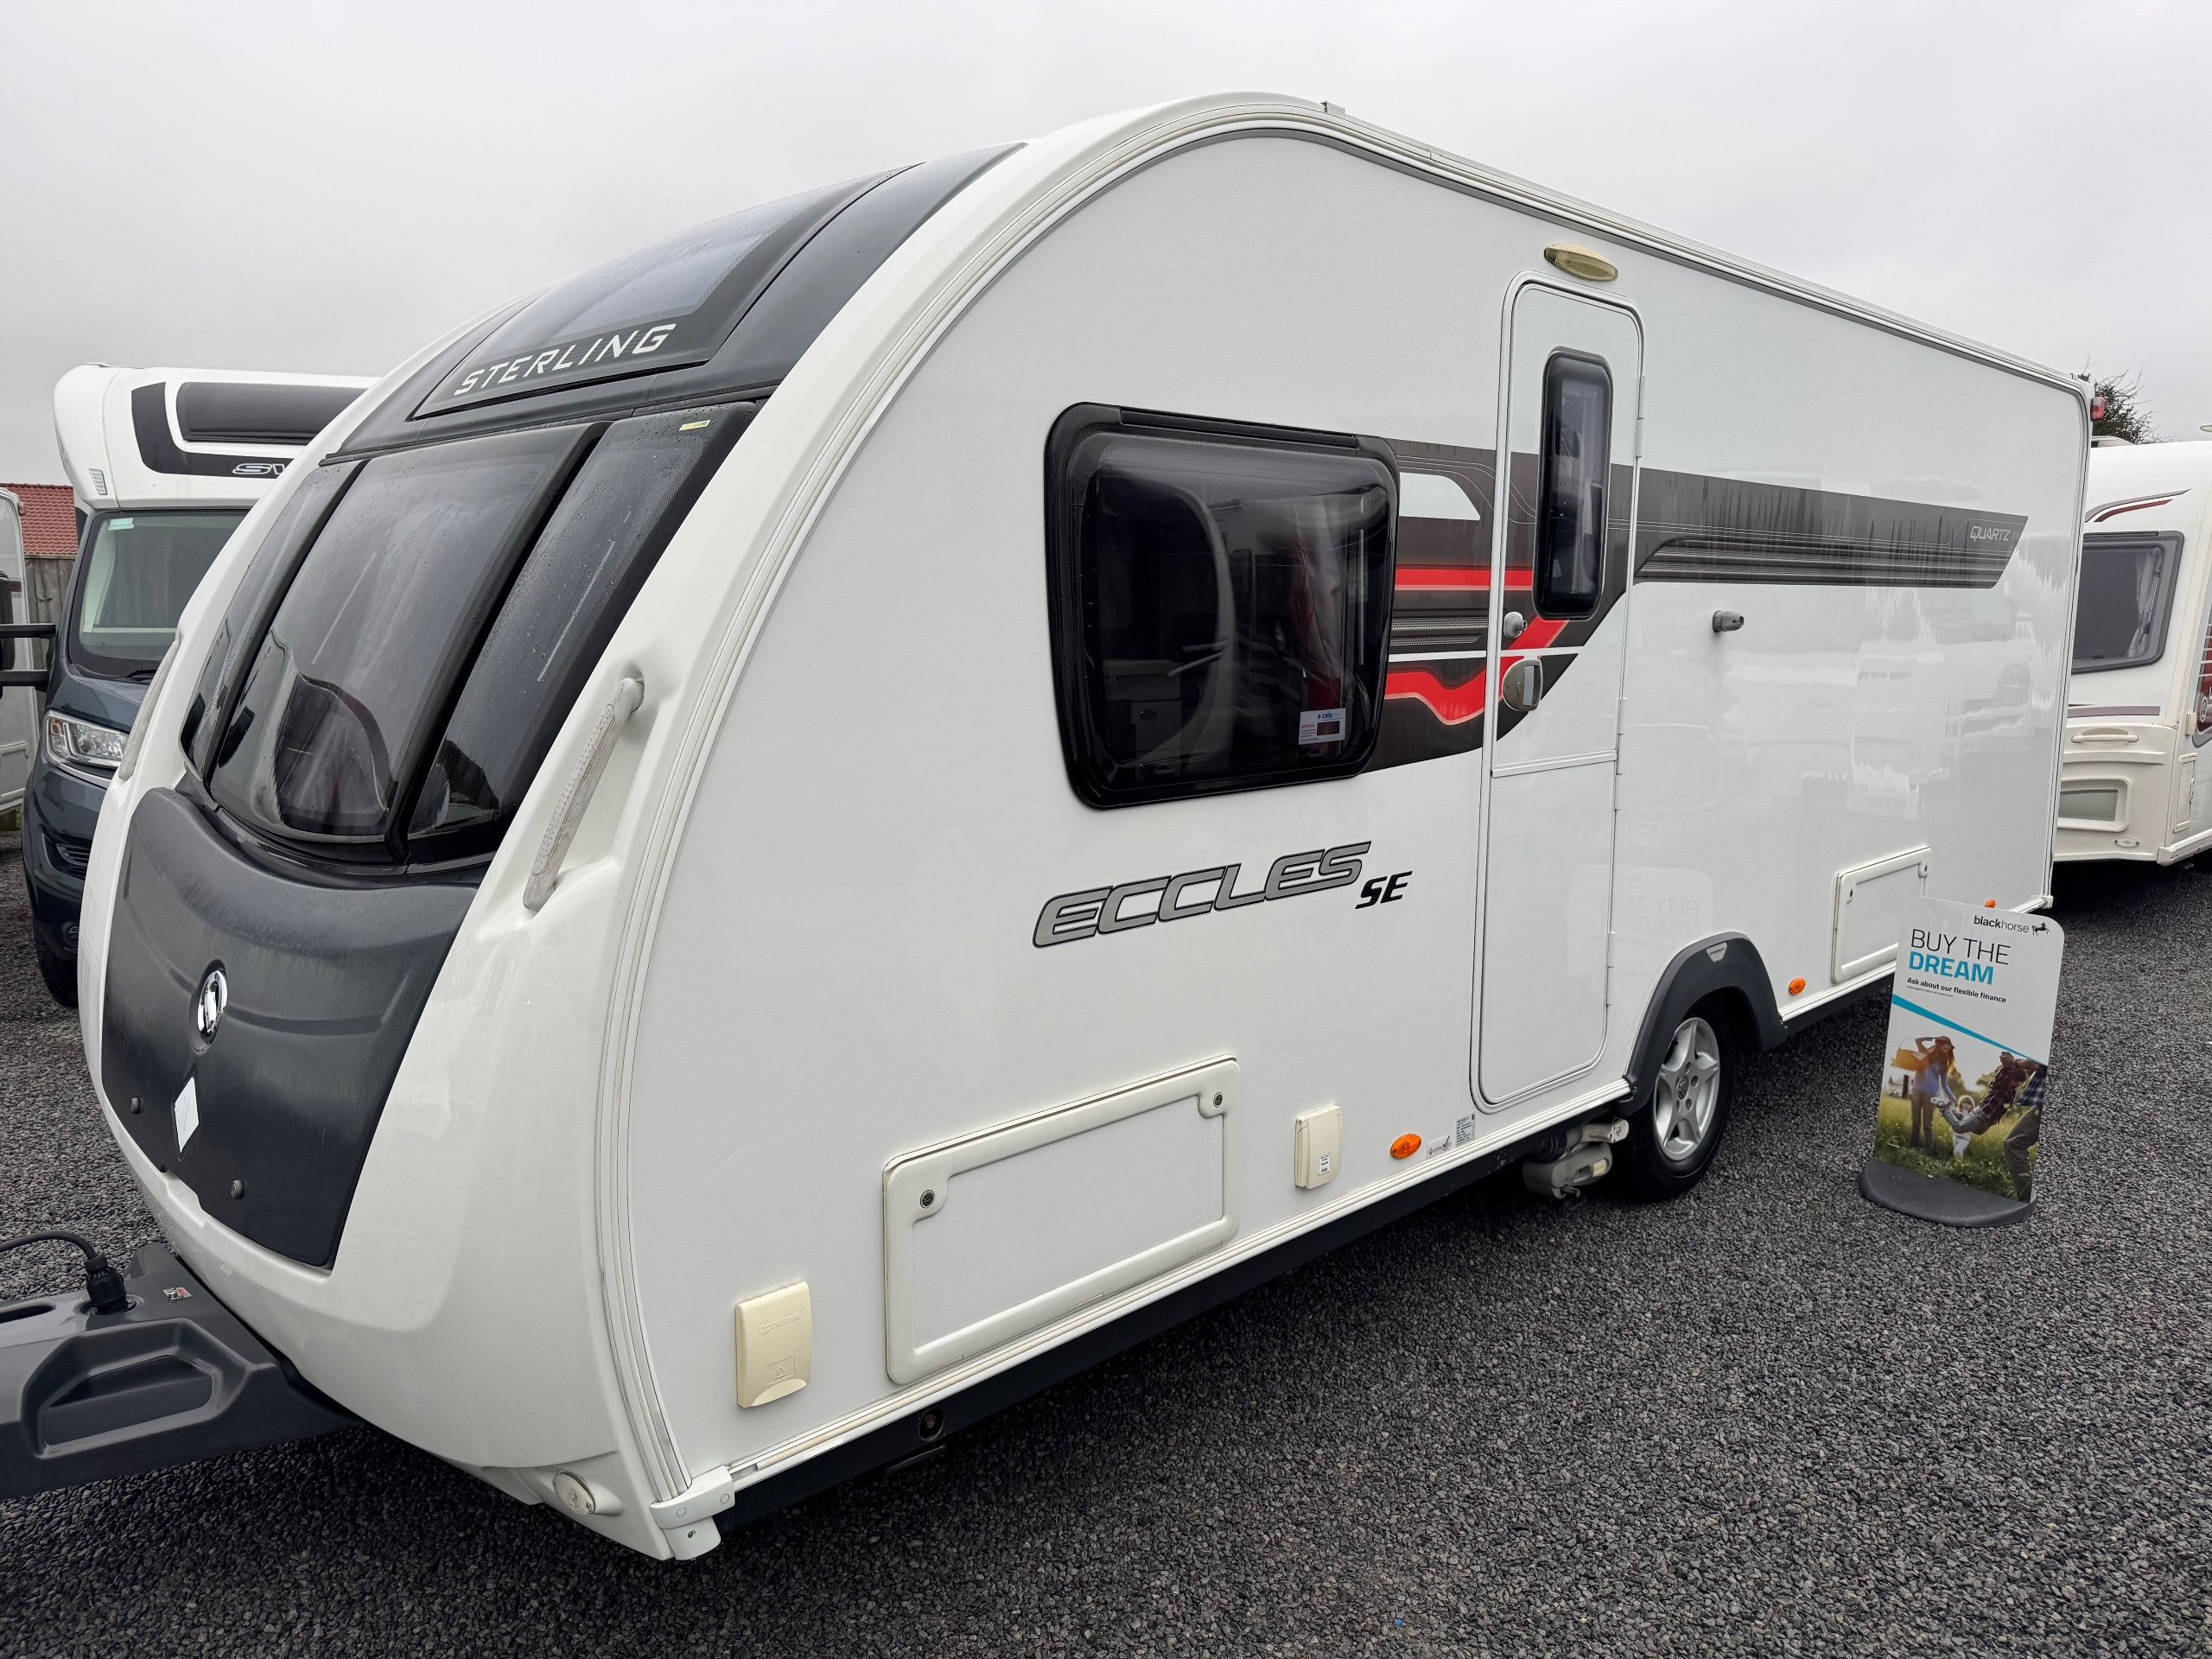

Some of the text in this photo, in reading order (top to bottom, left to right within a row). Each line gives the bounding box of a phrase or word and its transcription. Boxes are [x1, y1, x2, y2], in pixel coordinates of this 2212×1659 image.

[454, 323, 677, 396] STERLING
[1970, 525, 2012, 543] QUARTZ
[1033, 841, 1413, 949] ECCLES SE
[1974, 915, 2029, 933] blackhorse
[1910, 928, 2011, 965] BUY THE
[1908, 950, 1994, 985] DREAM
[1907, 977, 1919, 986] Ask
[1920, 980, 1940, 990] about
[1941, 984, 1953, 993] our
[1954, 986, 1979, 998] flexible
[1980, 992, 2006, 1003] finance
